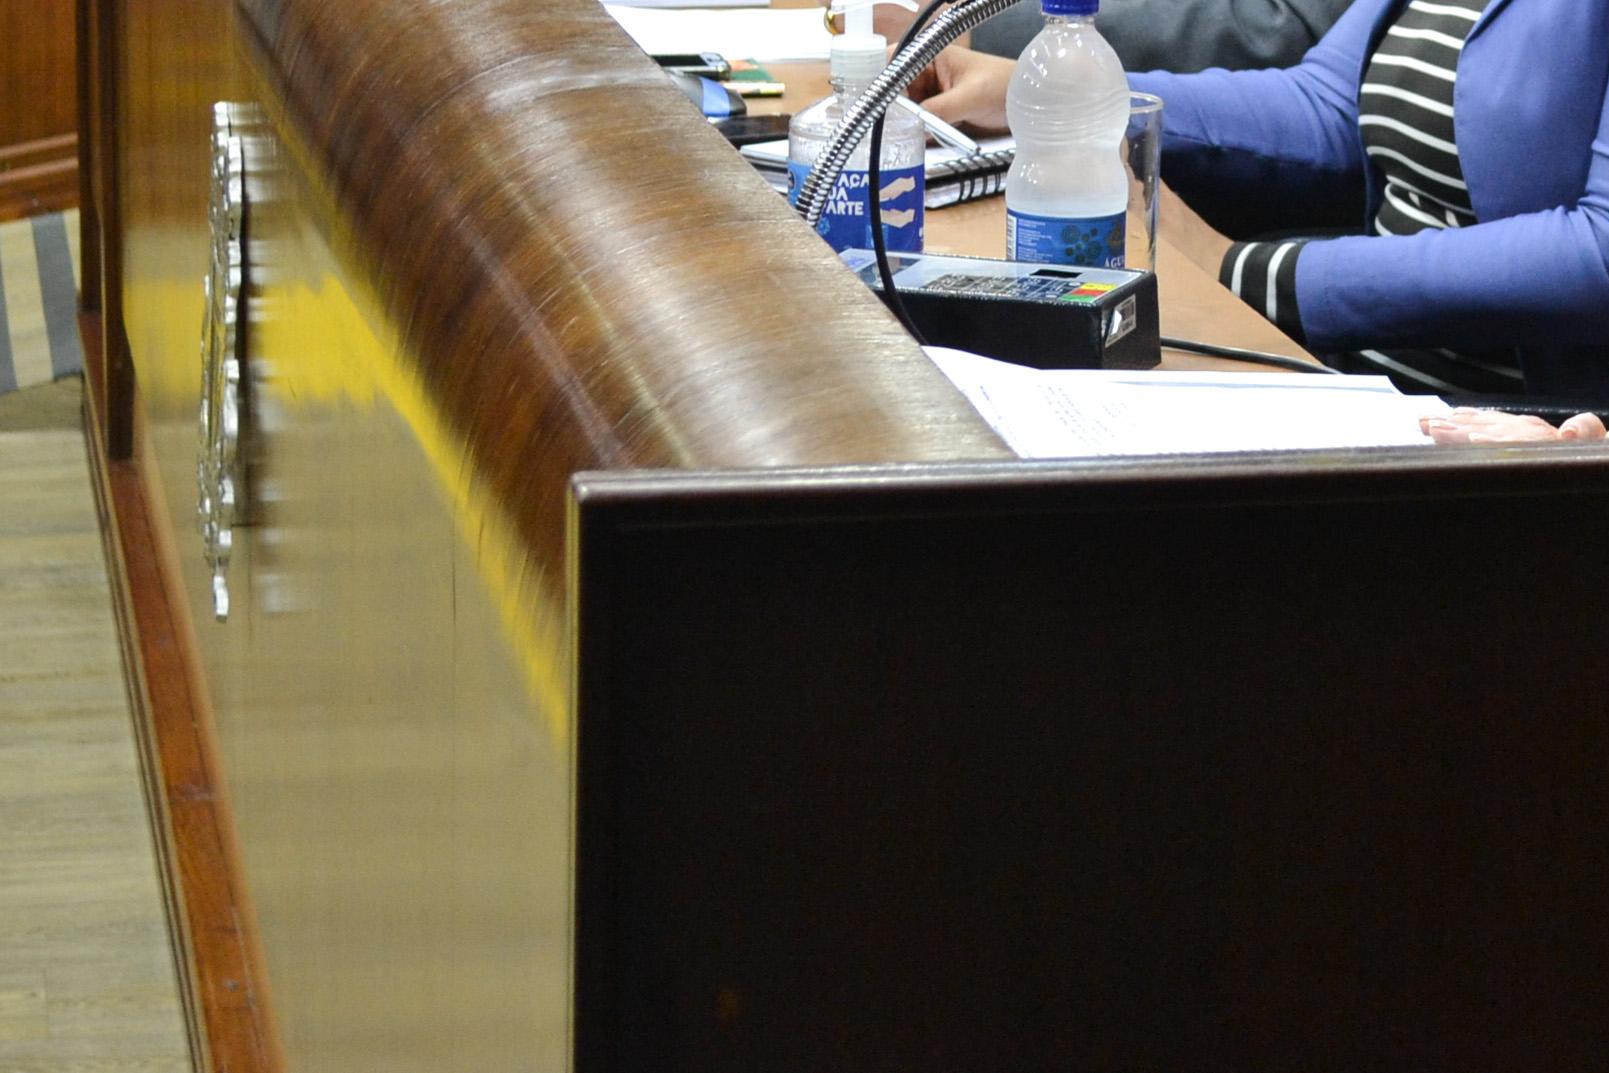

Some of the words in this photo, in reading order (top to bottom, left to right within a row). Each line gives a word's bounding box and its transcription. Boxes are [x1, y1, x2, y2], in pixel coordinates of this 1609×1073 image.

[835, 172, 869, 190] AÇA
[827, 185, 848, 201] UA
[824, 200, 864, 215] ARTE
